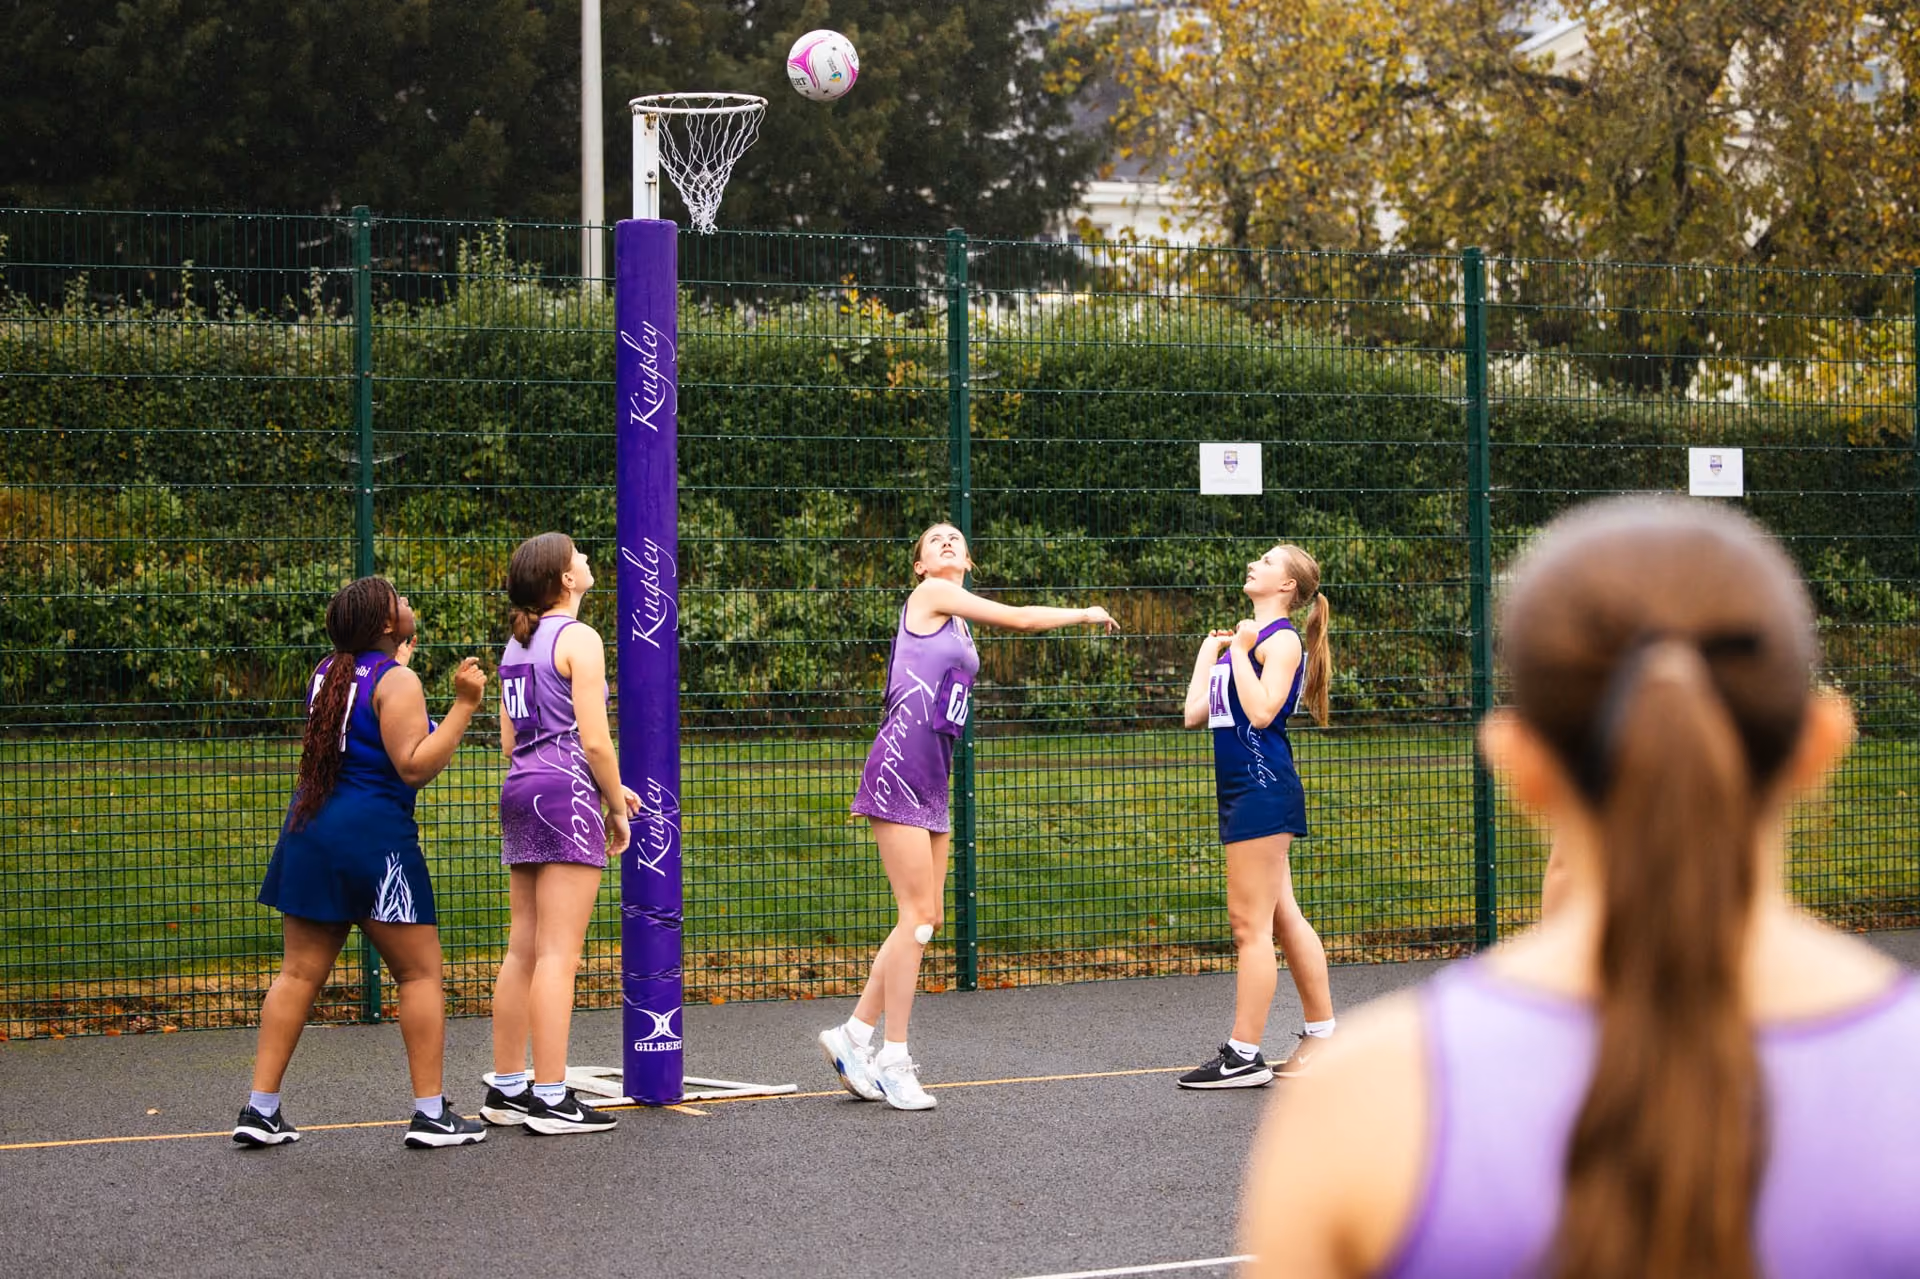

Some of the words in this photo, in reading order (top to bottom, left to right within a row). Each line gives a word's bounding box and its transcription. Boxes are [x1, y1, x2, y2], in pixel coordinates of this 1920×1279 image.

[620, 320, 678, 432] Kingsley
[621, 537, 679, 649] Kingsley
[503, 676, 530, 719] GK
[864, 668, 939, 813] Kingsley
[533, 720, 607, 856] ngsley
[637, 777, 682, 877] Kingley
